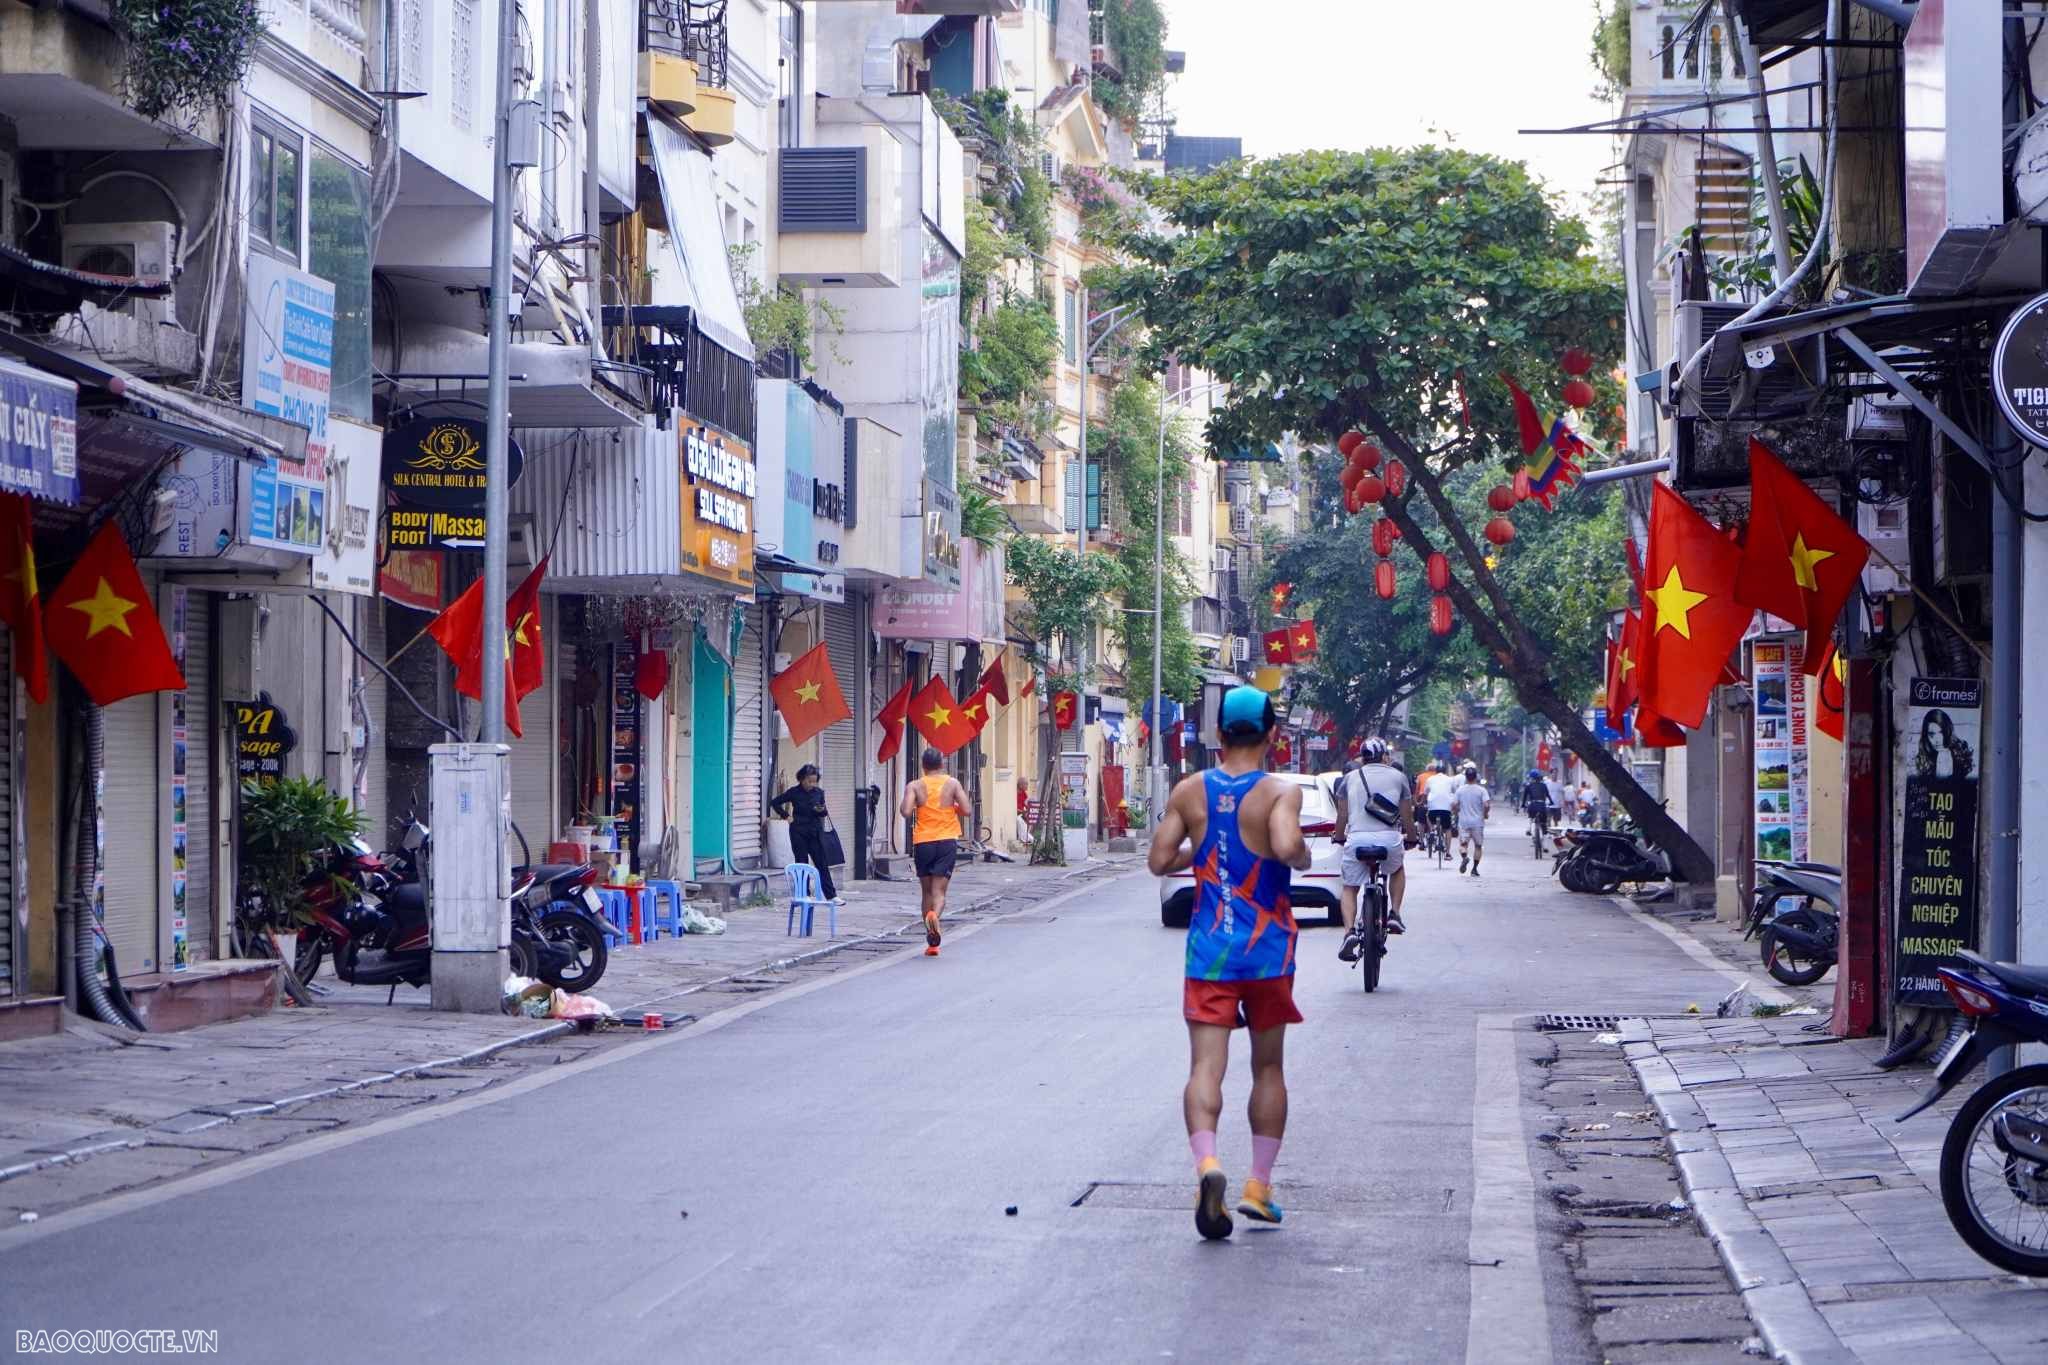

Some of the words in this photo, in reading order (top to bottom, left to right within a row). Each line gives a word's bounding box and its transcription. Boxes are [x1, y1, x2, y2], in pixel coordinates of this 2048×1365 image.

[141, 263, 160, 275] LG
[393, 473, 407, 487] SILK
[410, 474, 442, 487] CENTRAL
[444, 474, 466, 487] HOTEL
[468, 475, 475, 487] &
[392, 512, 429, 527] BODY
[433, 513, 487, 538] Massa
[391, 530, 427, 545] FOOT
[1789, 643, 1805, 702] EXCHANGE
[1932, 685, 1977, 701] framesi
[1791, 707, 1806, 745] MONEY
[1928, 792, 1954, 815] TẠO
[1926, 814, 1954, 839] MẪU
[1217, 829, 1228, 862] FPT
[1926, 846, 1950, 868] TÓC
[1911, 875, 1963, 896] CHUYÊN
[1911, 903, 1960, 927] NGHIỆP
[1900, 977, 1914, 990] 22
[1915, 975, 1941, 991] HÀNG
